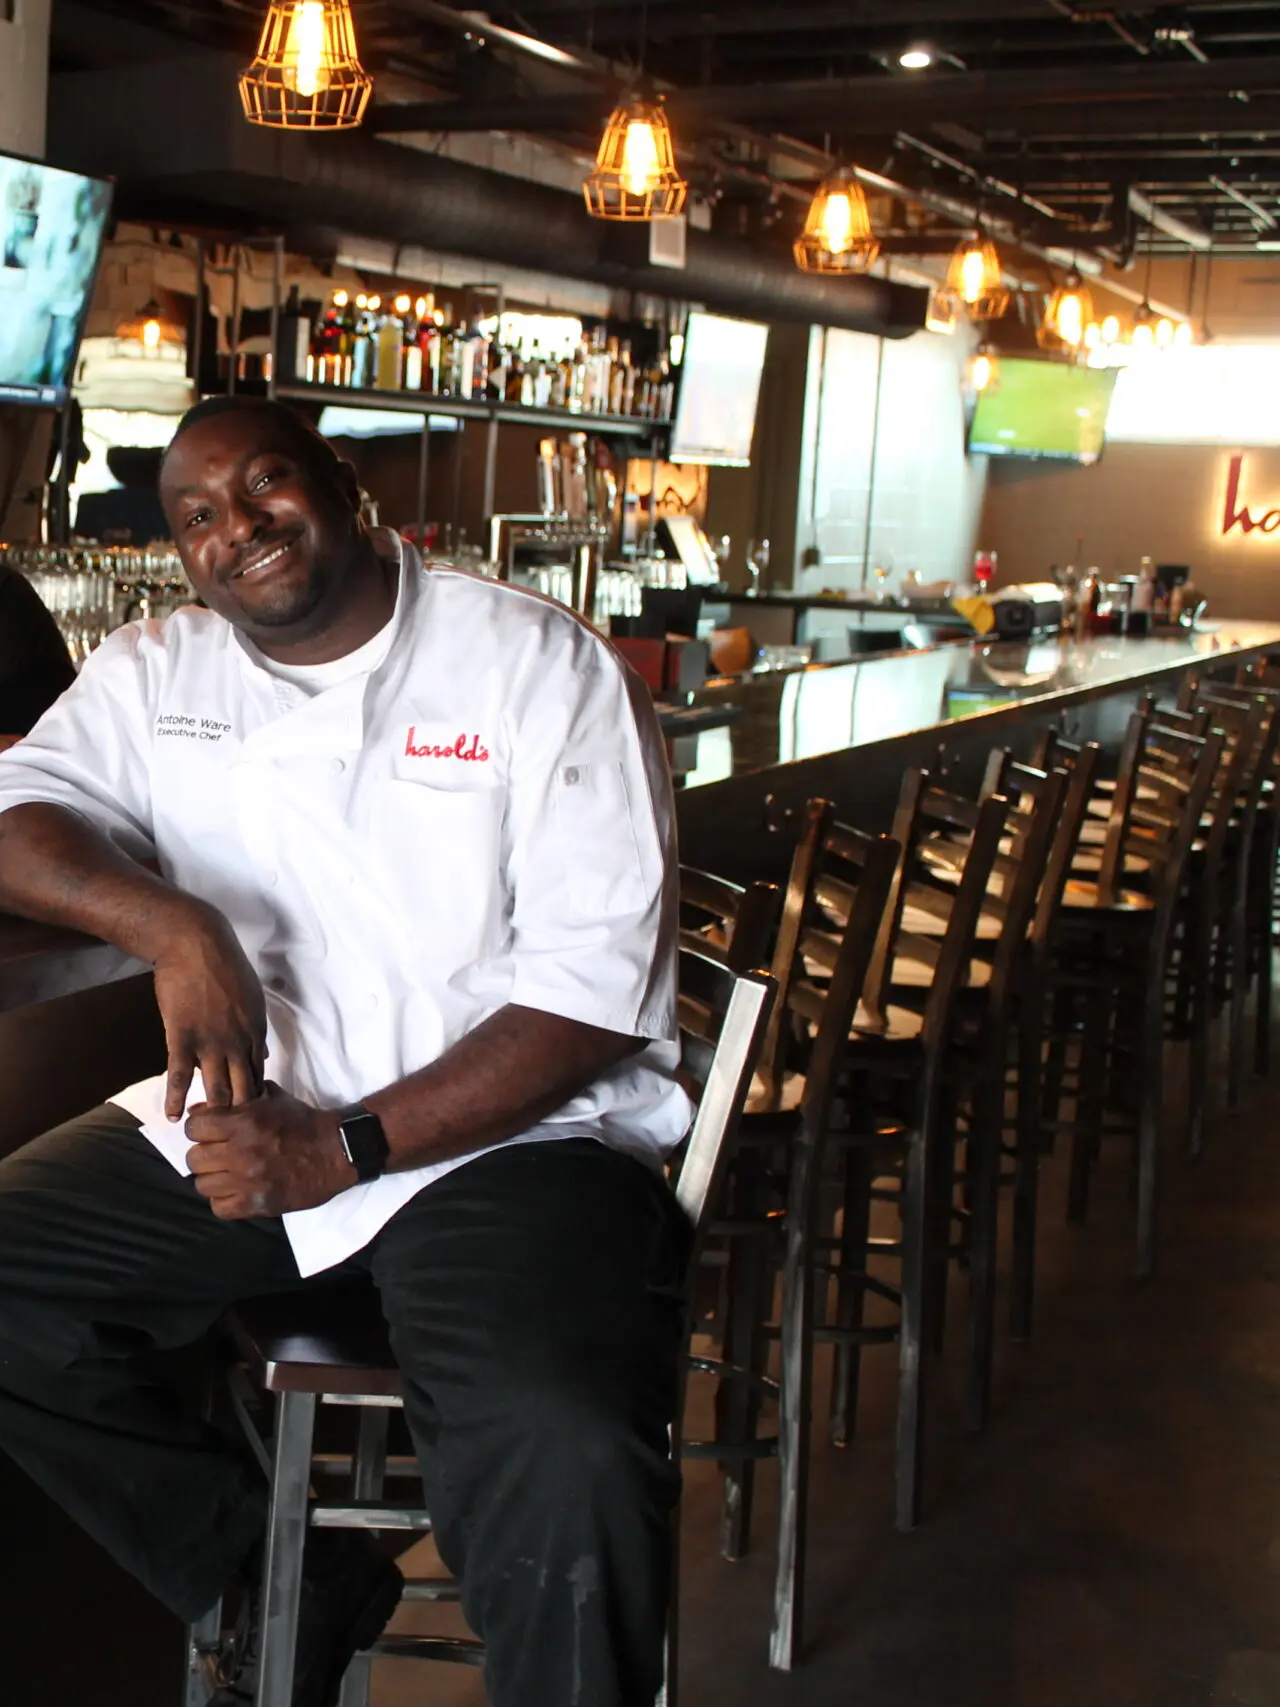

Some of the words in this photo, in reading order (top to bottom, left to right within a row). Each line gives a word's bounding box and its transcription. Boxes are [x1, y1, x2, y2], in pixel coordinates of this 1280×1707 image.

[156, 714, 197, 727] Antoine
[200, 718, 232, 733] Ware
[157, 727, 197, 738] Executive
[198, 731, 222, 742] Chef
[404, 726, 489, 762] harold's
